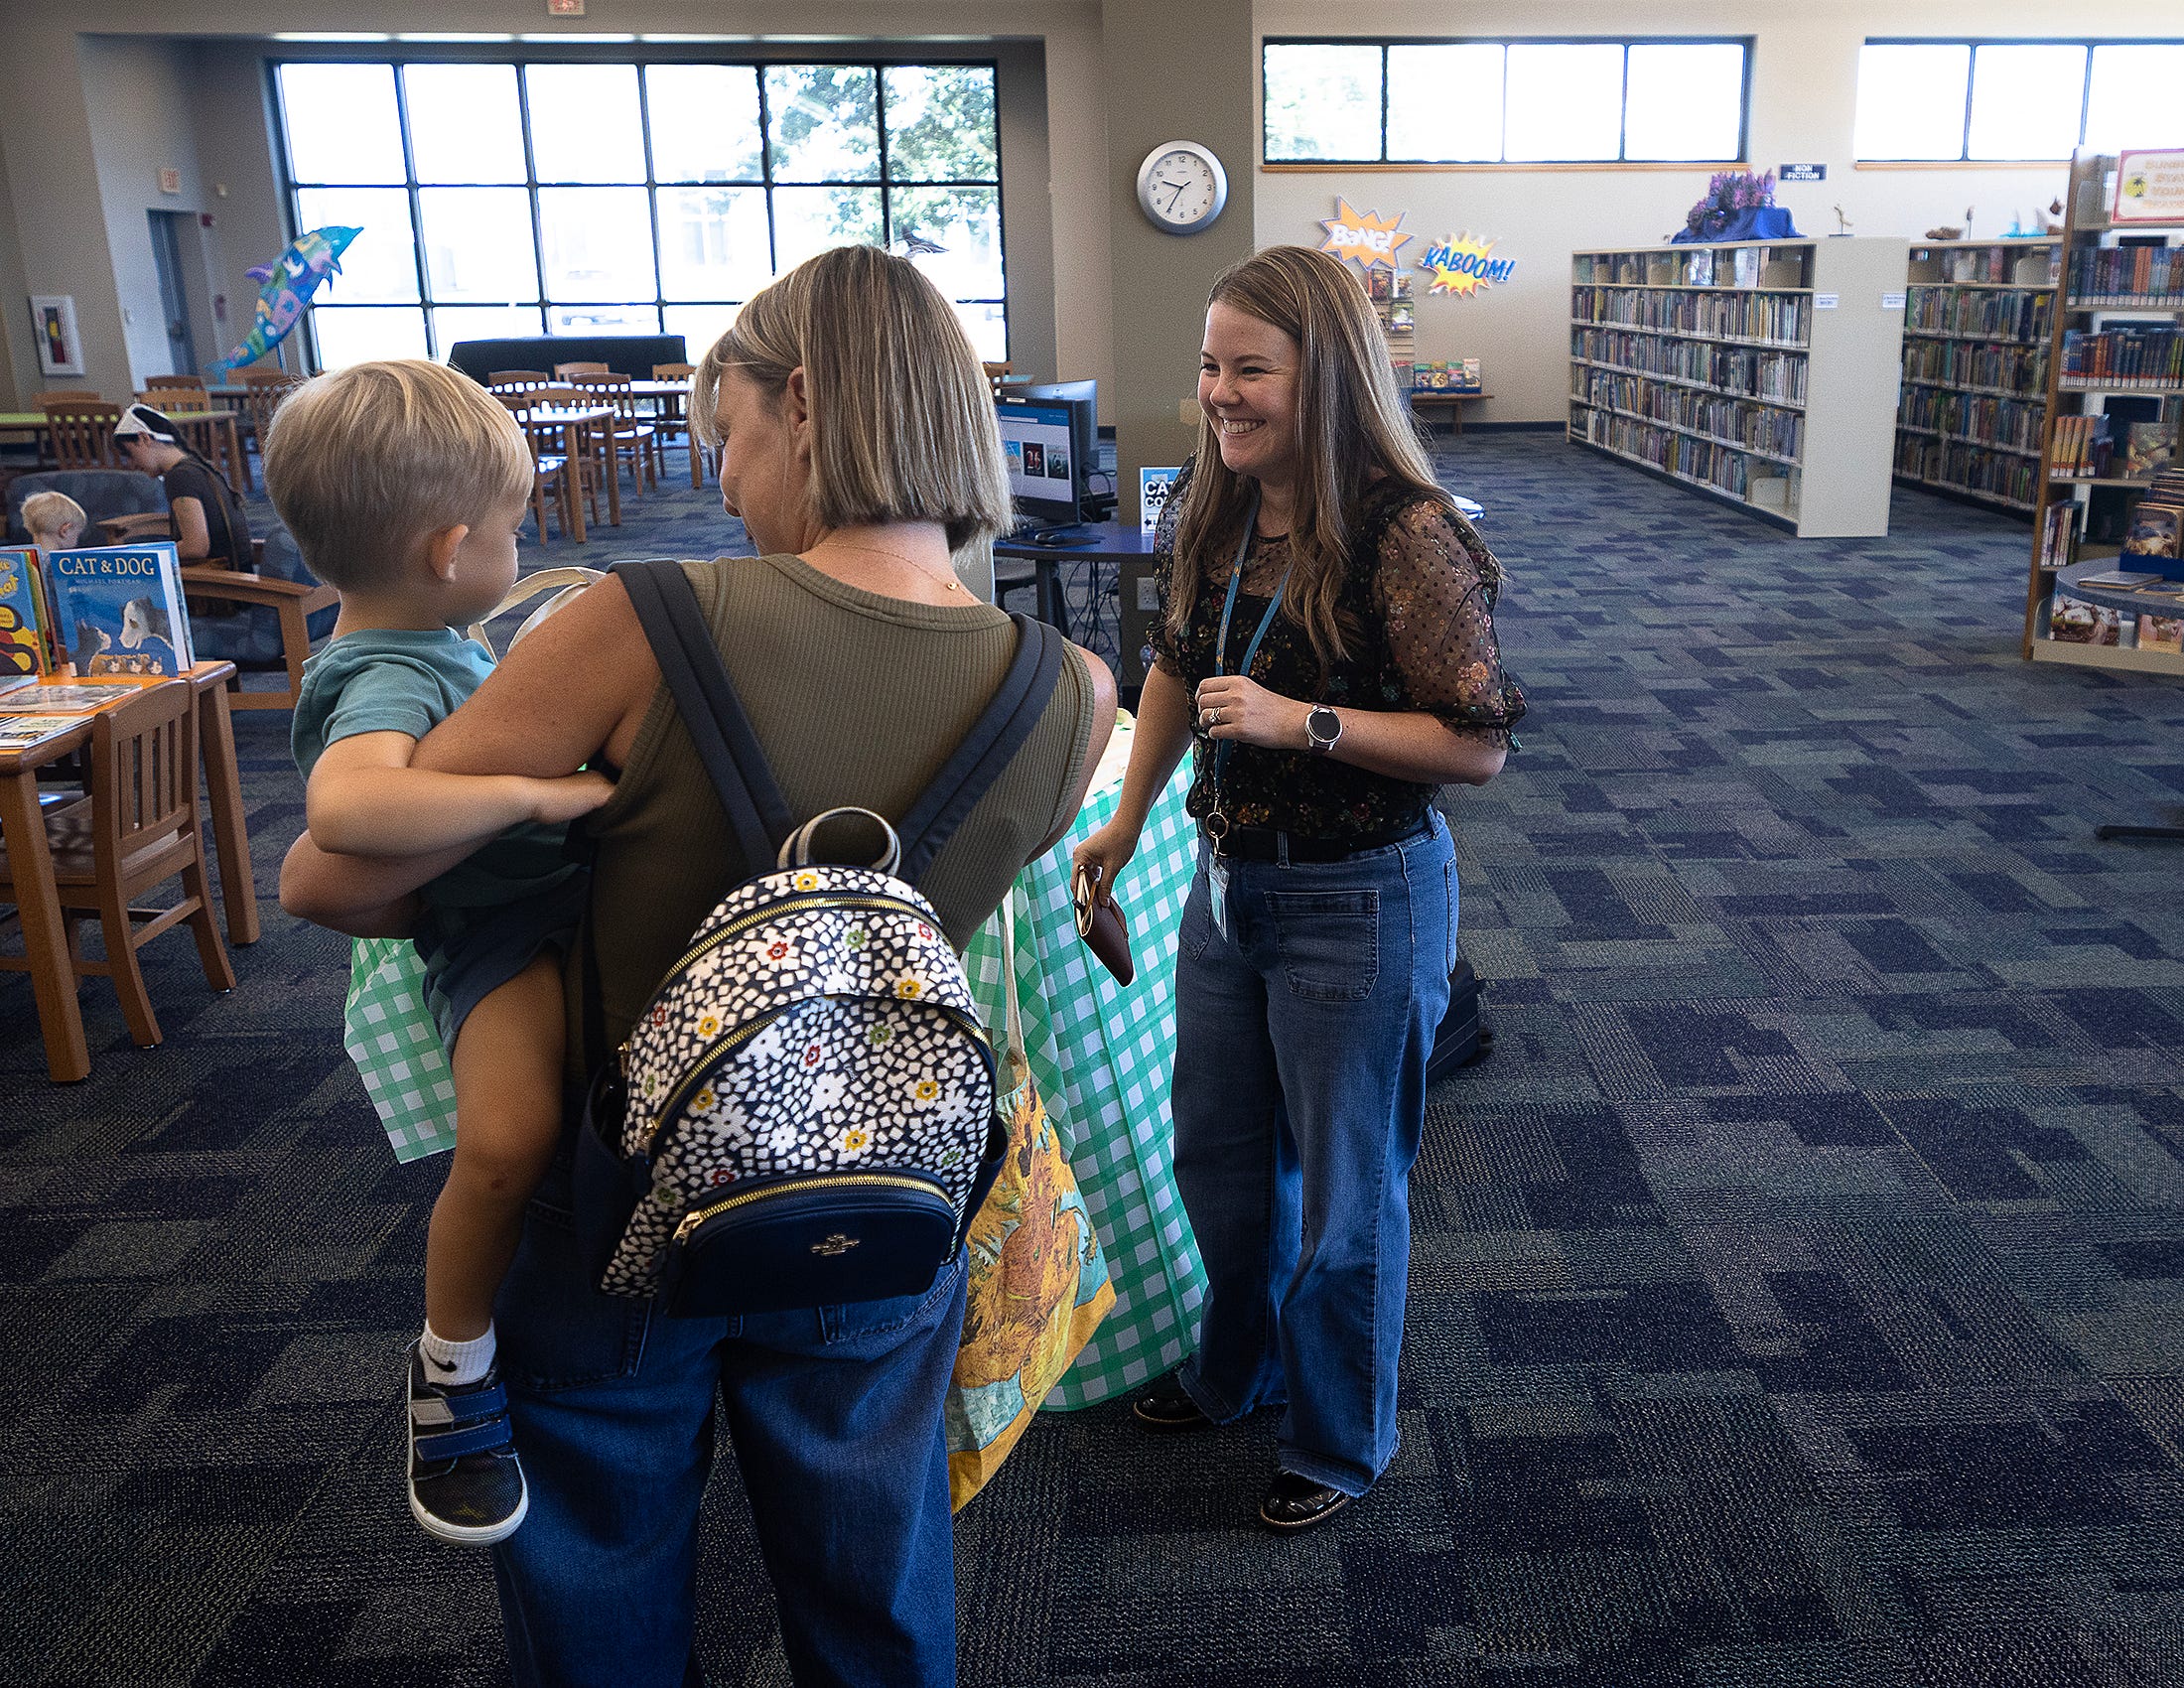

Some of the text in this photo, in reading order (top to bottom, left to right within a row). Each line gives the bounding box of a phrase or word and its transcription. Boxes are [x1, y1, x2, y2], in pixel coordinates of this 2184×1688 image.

[1423, 245, 1516, 281] KABOOM!
[1145, 481, 1173, 495] CA
[1145, 496, 1167, 507] CO
[59, 557, 155, 576] CAT & DOG
